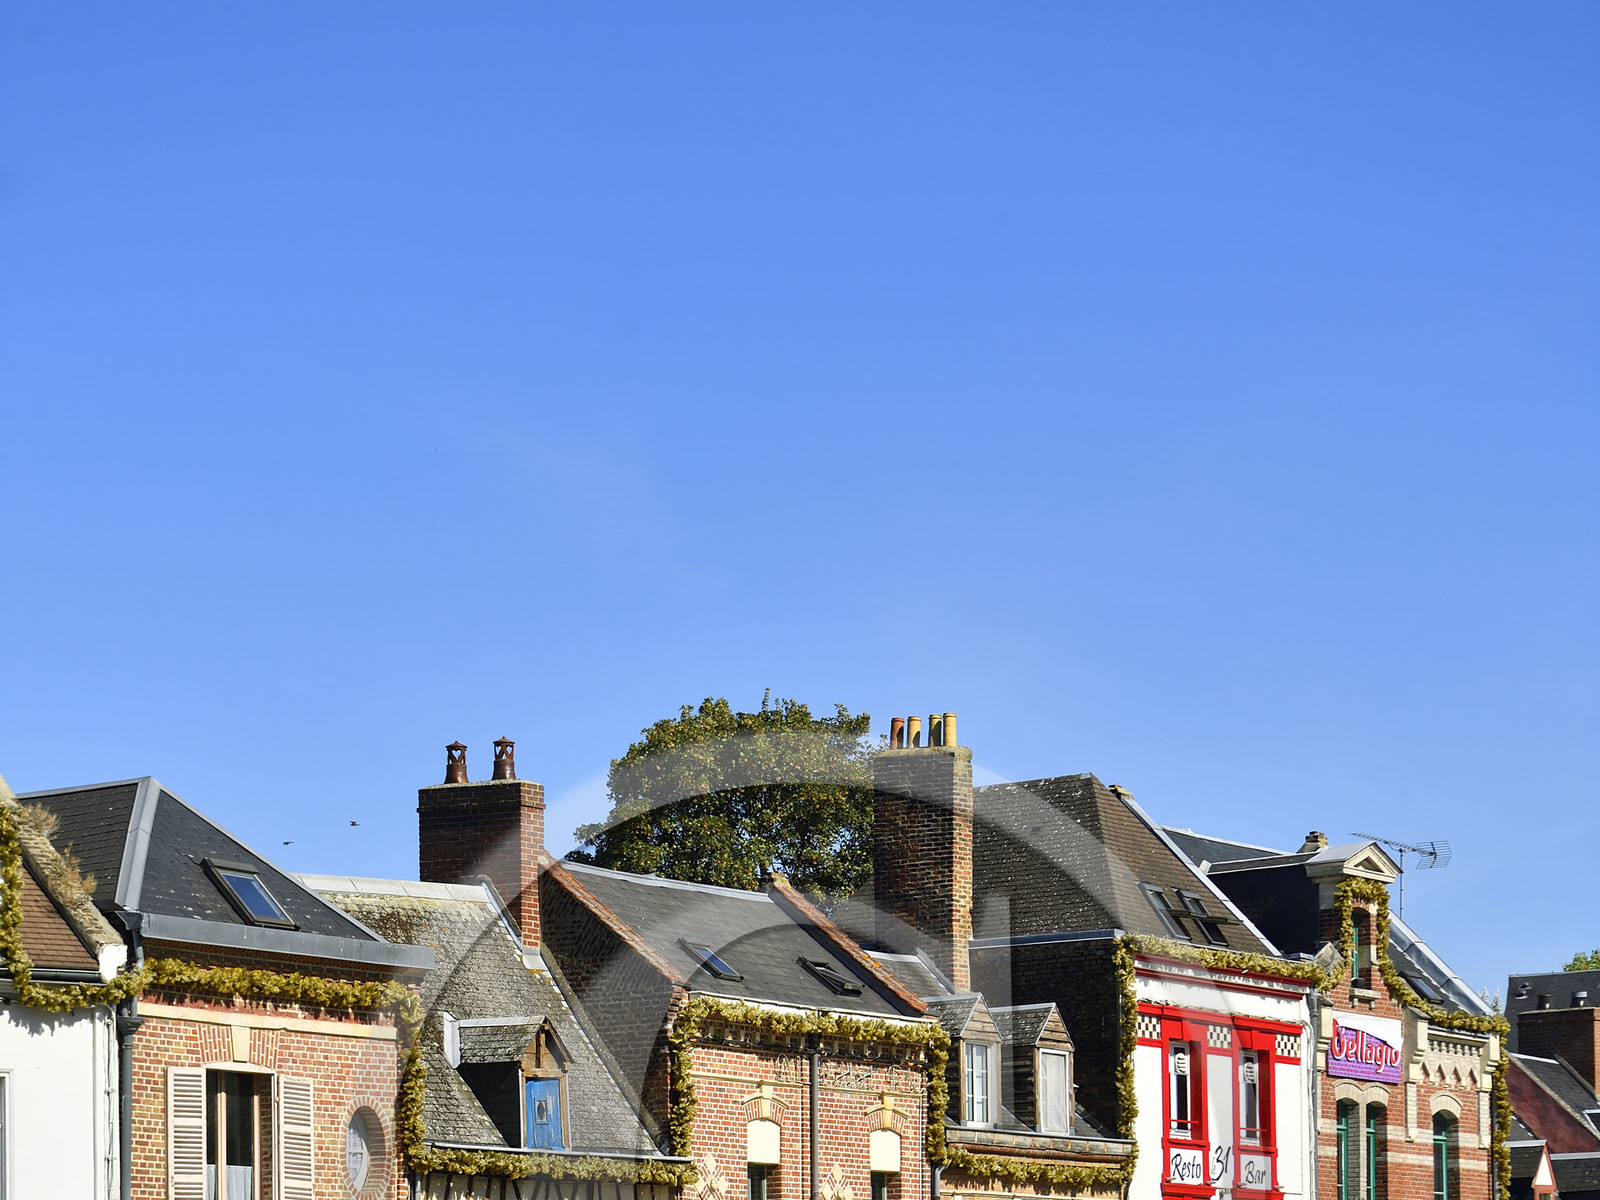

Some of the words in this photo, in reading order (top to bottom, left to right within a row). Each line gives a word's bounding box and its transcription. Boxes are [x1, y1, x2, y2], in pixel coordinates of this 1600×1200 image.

[1170, 1153, 1202, 1182] Resto
[1211, 1145, 1231, 1181] 31
[1244, 1160, 1266, 1184] Bar
